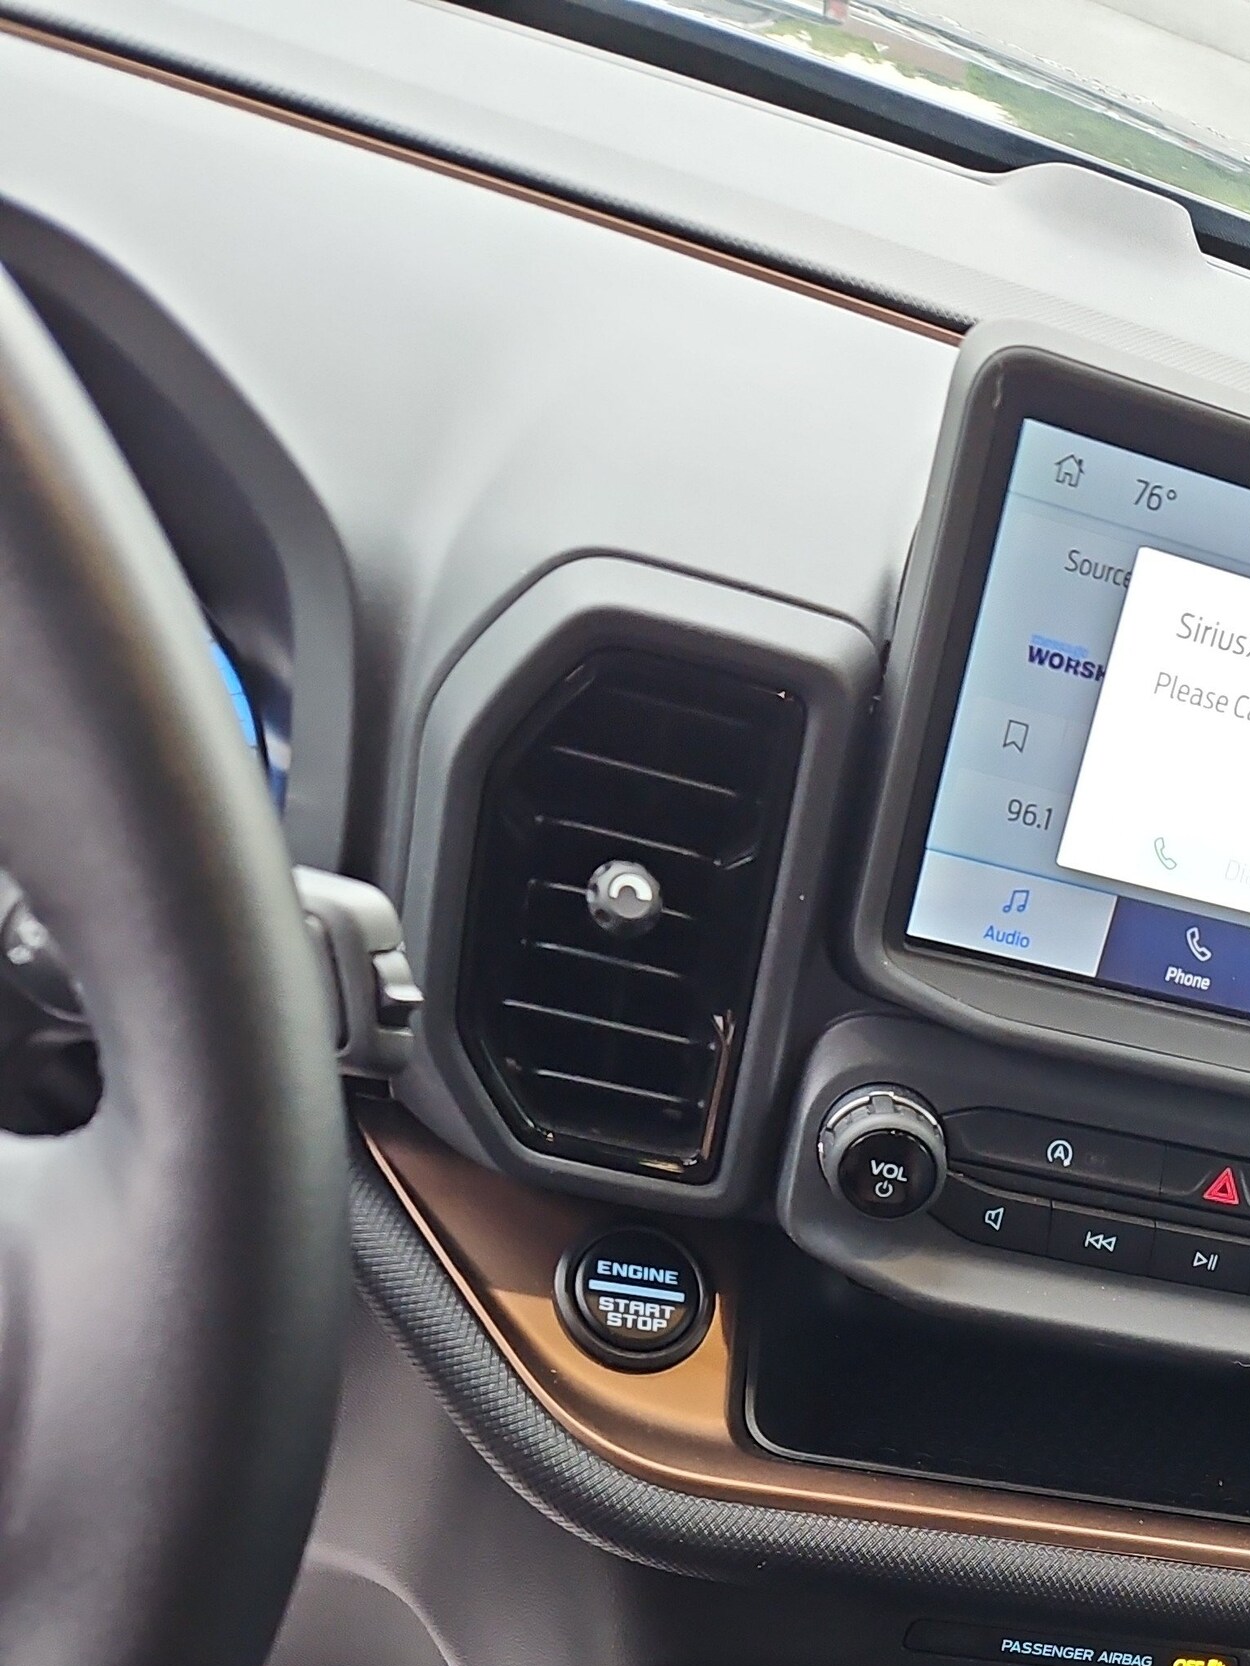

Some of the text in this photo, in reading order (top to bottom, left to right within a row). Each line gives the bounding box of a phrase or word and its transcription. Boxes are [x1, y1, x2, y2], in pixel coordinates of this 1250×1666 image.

[1132, 479, 1177, 511] 76°
[1154, 672, 1229, 713] Please
[1007, 799, 1053, 830] 96.1
[983, 925, 1030, 949] Audio
[1165, 966, 1210, 990] Phone
[871, 1160, 908, 1182] VOL
[596, 1260, 679, 1285] ENGINE
[599, 1296, 675, 1319] START
[607, 1312, 667, 1332] STOP
[1001, 1639, 1094, 1662] PASSENGER
